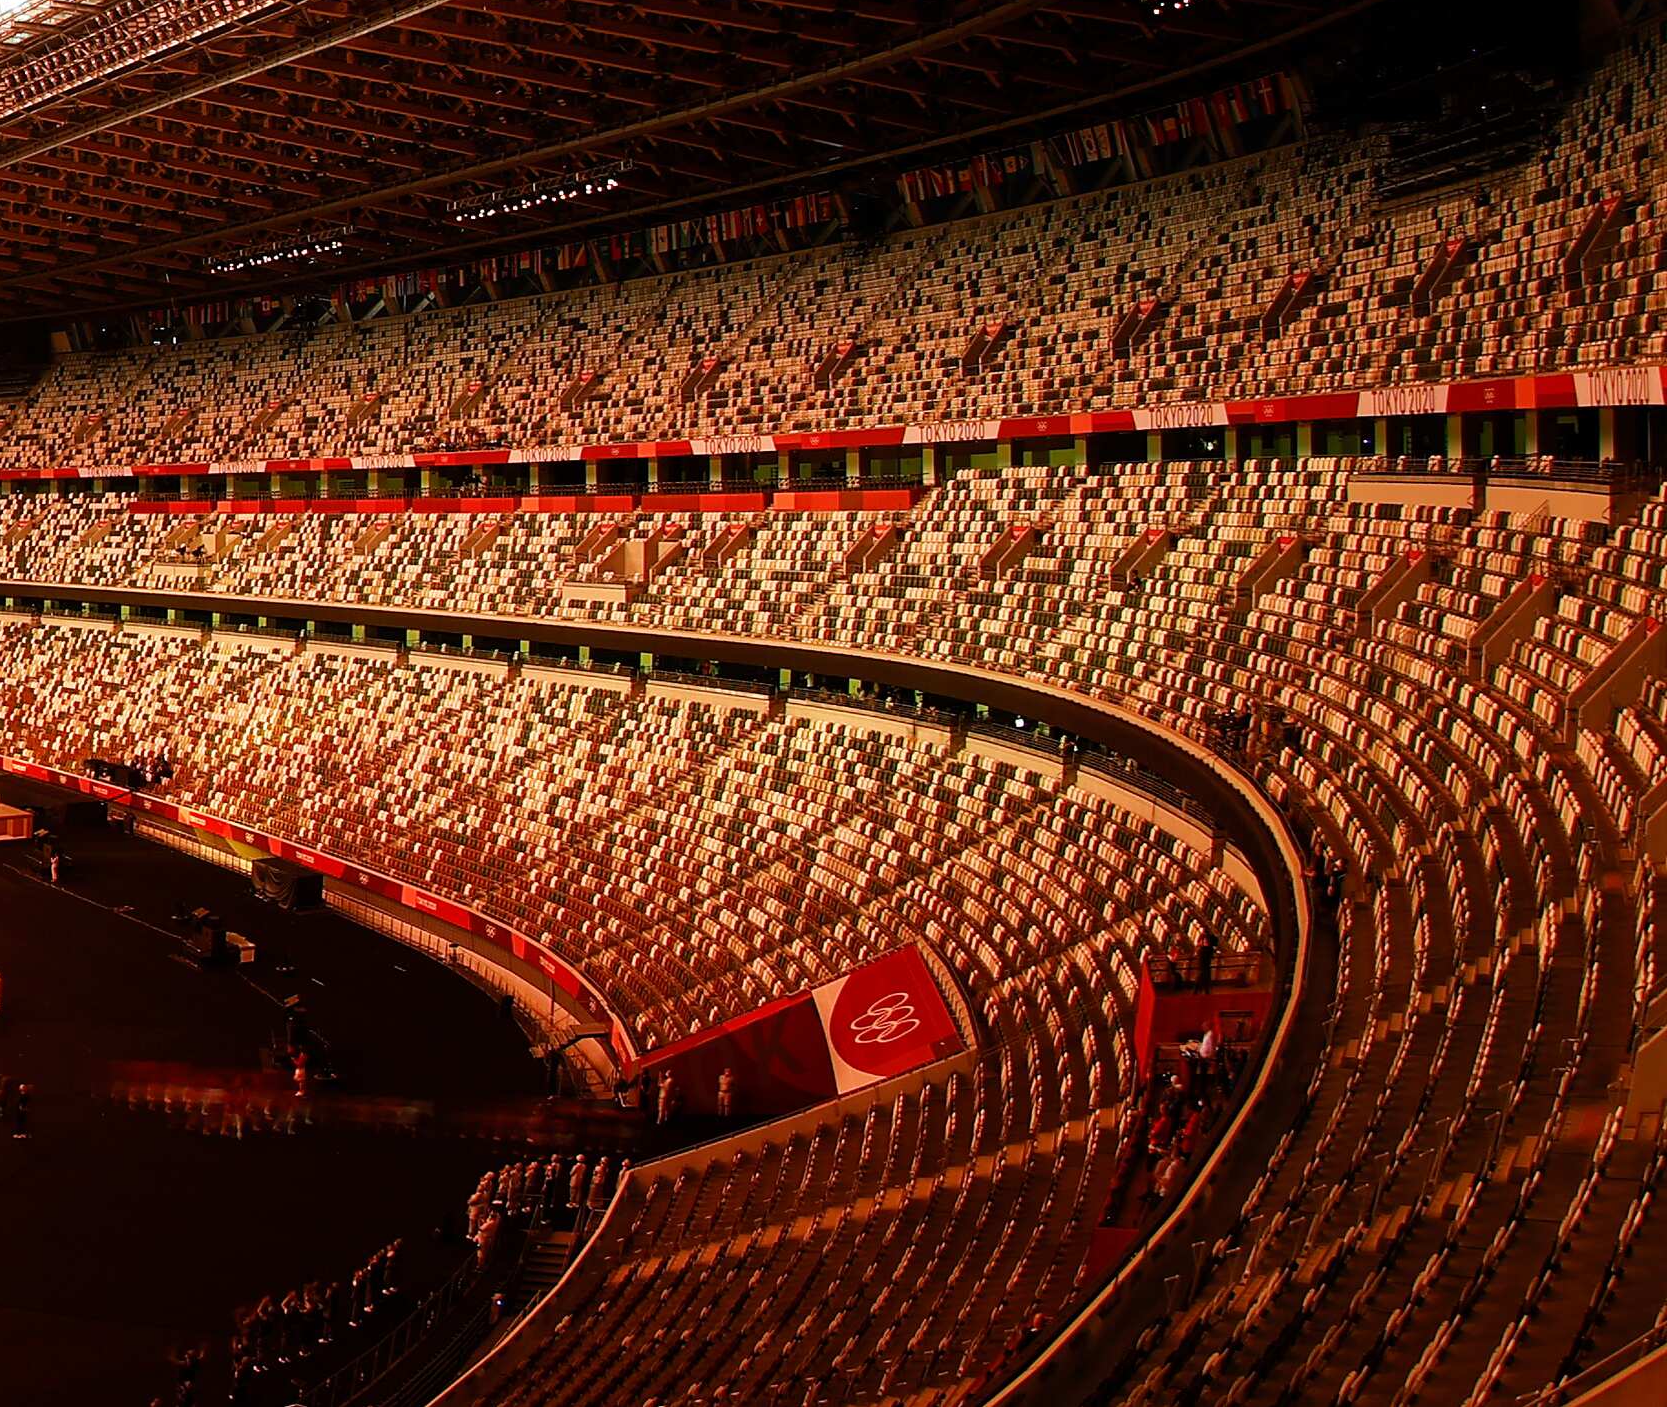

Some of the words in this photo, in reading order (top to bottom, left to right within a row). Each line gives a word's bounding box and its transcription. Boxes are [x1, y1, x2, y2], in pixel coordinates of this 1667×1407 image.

[1588, 370, 1621, 405] TOKYO
[1624, 368, 1649, 404] 2020
[1372, 389, 1406, 414] TOKYO
[1409, 387, 1435, 412] 2020
[1149, 406, 1184, 427] TOKYO
[1187, 405, 1213, 426] 2020
[919, 424, 954, 442] TOKYO
[958, 423, 985, 440] 2020
[520, 449, 547, 462] TOKYO
[549, 448, 570, 461] 2020
[704, 439, 735, 454] TOKYO
[738, 438, 761, 453] 2020
[361, 457, 384, 468] TOKYO
[387, 456, 405, 467] 2020
